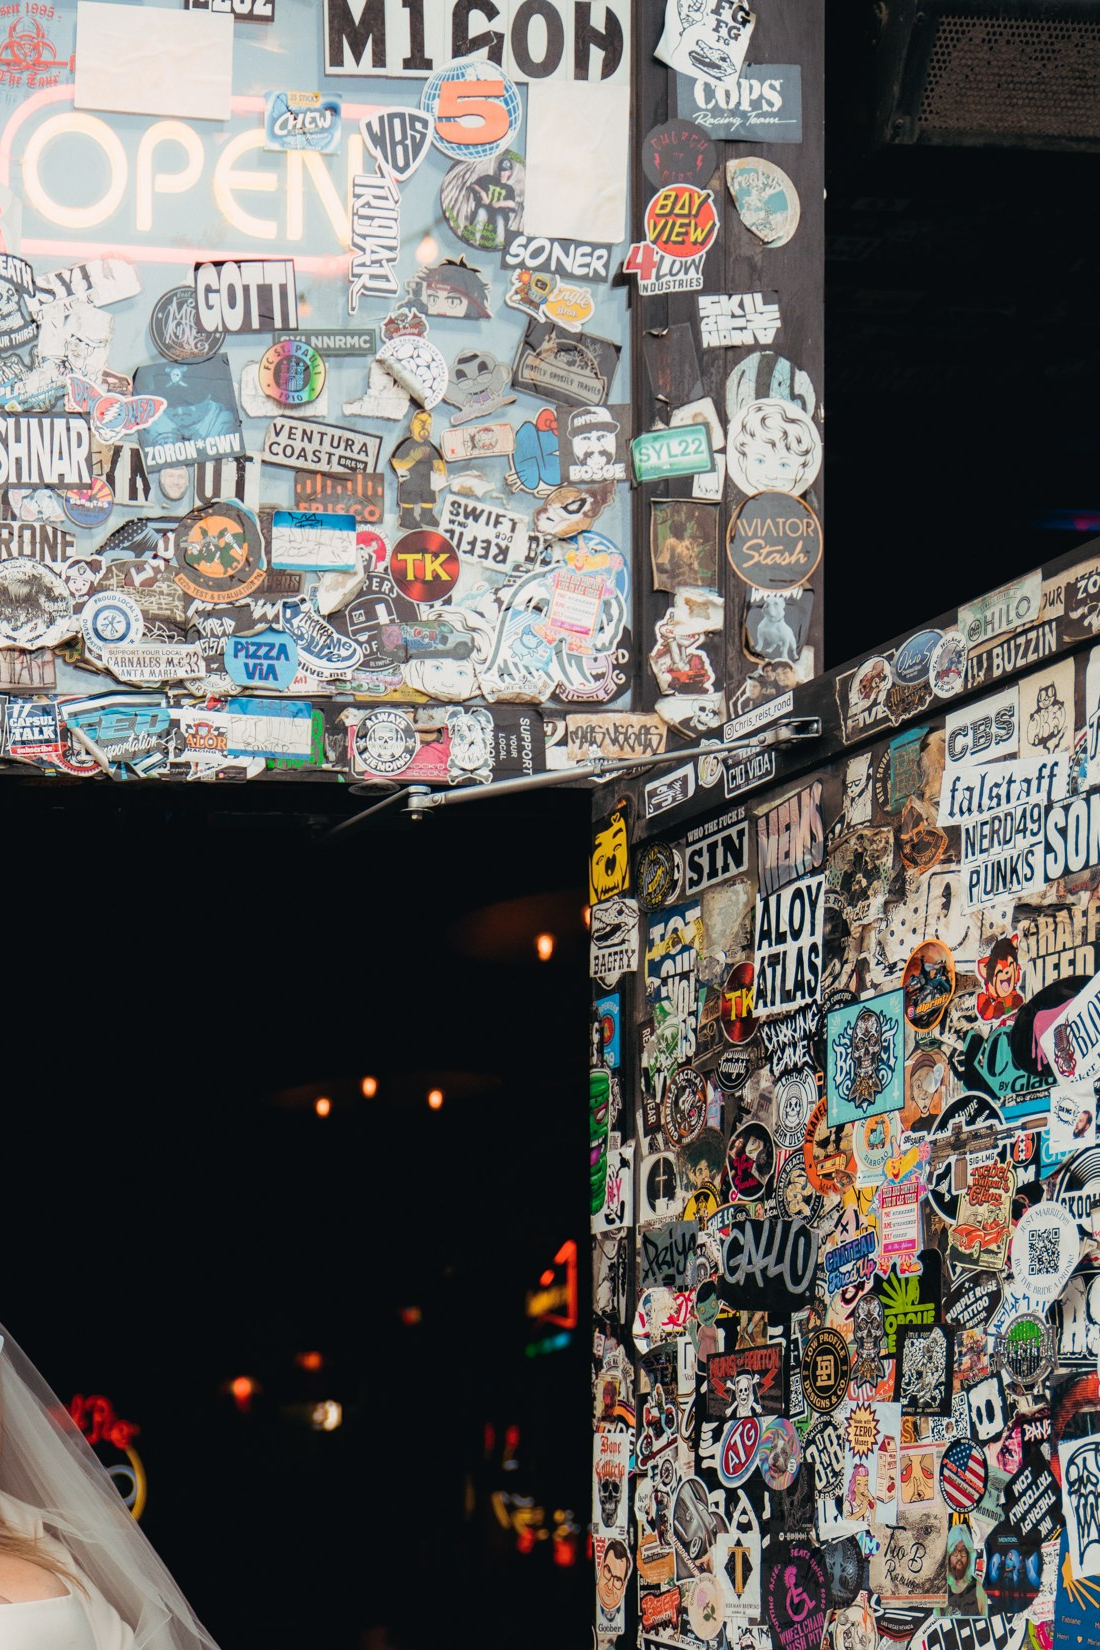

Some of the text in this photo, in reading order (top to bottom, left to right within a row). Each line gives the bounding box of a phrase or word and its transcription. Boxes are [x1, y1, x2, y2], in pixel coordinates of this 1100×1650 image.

[435, 80, 510, 145] 5
[695, 79, 783, 112] COPS
[22, 110, 362, 252] OPEN
[649, 220, 714, 244] VIEW
[506, 237, 608, 276] SONER
[626, 245, 702, 280] 4 LOW
[199, 264, 297, 332] GOTTI
[640, 278, 701, 293] INDUSTRIES
[10, 325, 38, 345] THIRST
[269, 443, 365, 470] COAST BREW
[273, 425, 371, 456] VENTURA
[638, 439, 704, 463] SYL22
[399, 555, 451, 581] TK
[742, 541, 807, 567] Stash
[991, 623, 1057, 679] BUZZIN
[949, 704, 1014, 761] CBS
[948, 760, 1060, 818] falstaff
[686, 829, 748, 892] SIN
[968, 849, 1035, 897] PUNKS
[758, 883, 822, 949] ALOY
[755, 943, 821, 1013] ATLAS
[968, 1155, 996, 1165] SIG-LMG
[826, 1232, 875, 1271] CHATEAU
[853, 1426, 872, 1438] ZERO
